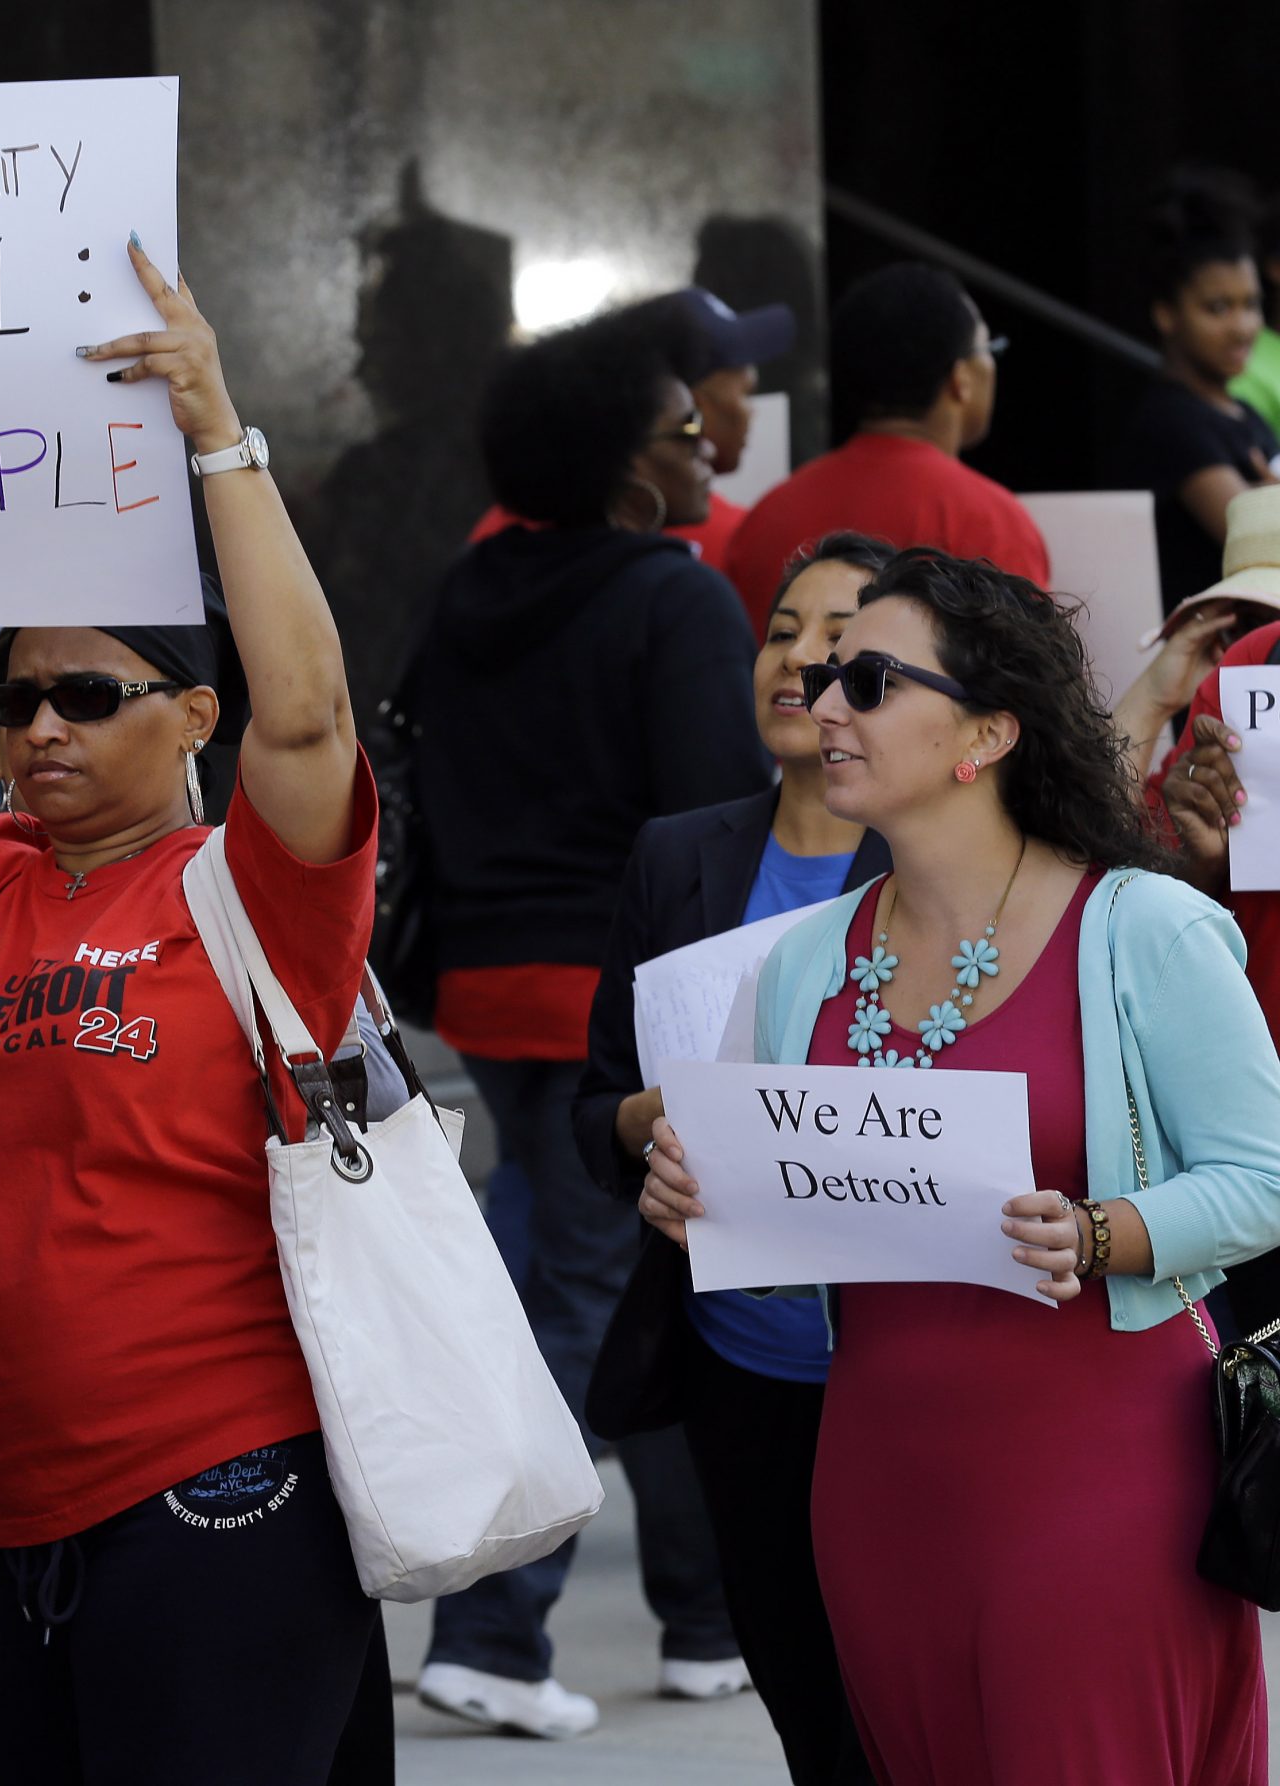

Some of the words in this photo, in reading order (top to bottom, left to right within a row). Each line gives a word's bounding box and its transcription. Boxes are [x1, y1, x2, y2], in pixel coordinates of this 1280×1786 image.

[74, 940, 161, 968] HERE
[73, 1006, 157, 1061] 24
[756, 1088, 839, 1135] We
[855, 1091, 942, 1140] Are
[774, 1160, 947, 1207] Detroit
[220, 1478, 243, 1490] NYC
[228, 1461, 267, 1482] Dept.
[163, 1490, 210, 1529] NINETEEN
[214, 1507, 264, 1529] EIGHTY
[267, 1473, 299, 1512] SEVEN
